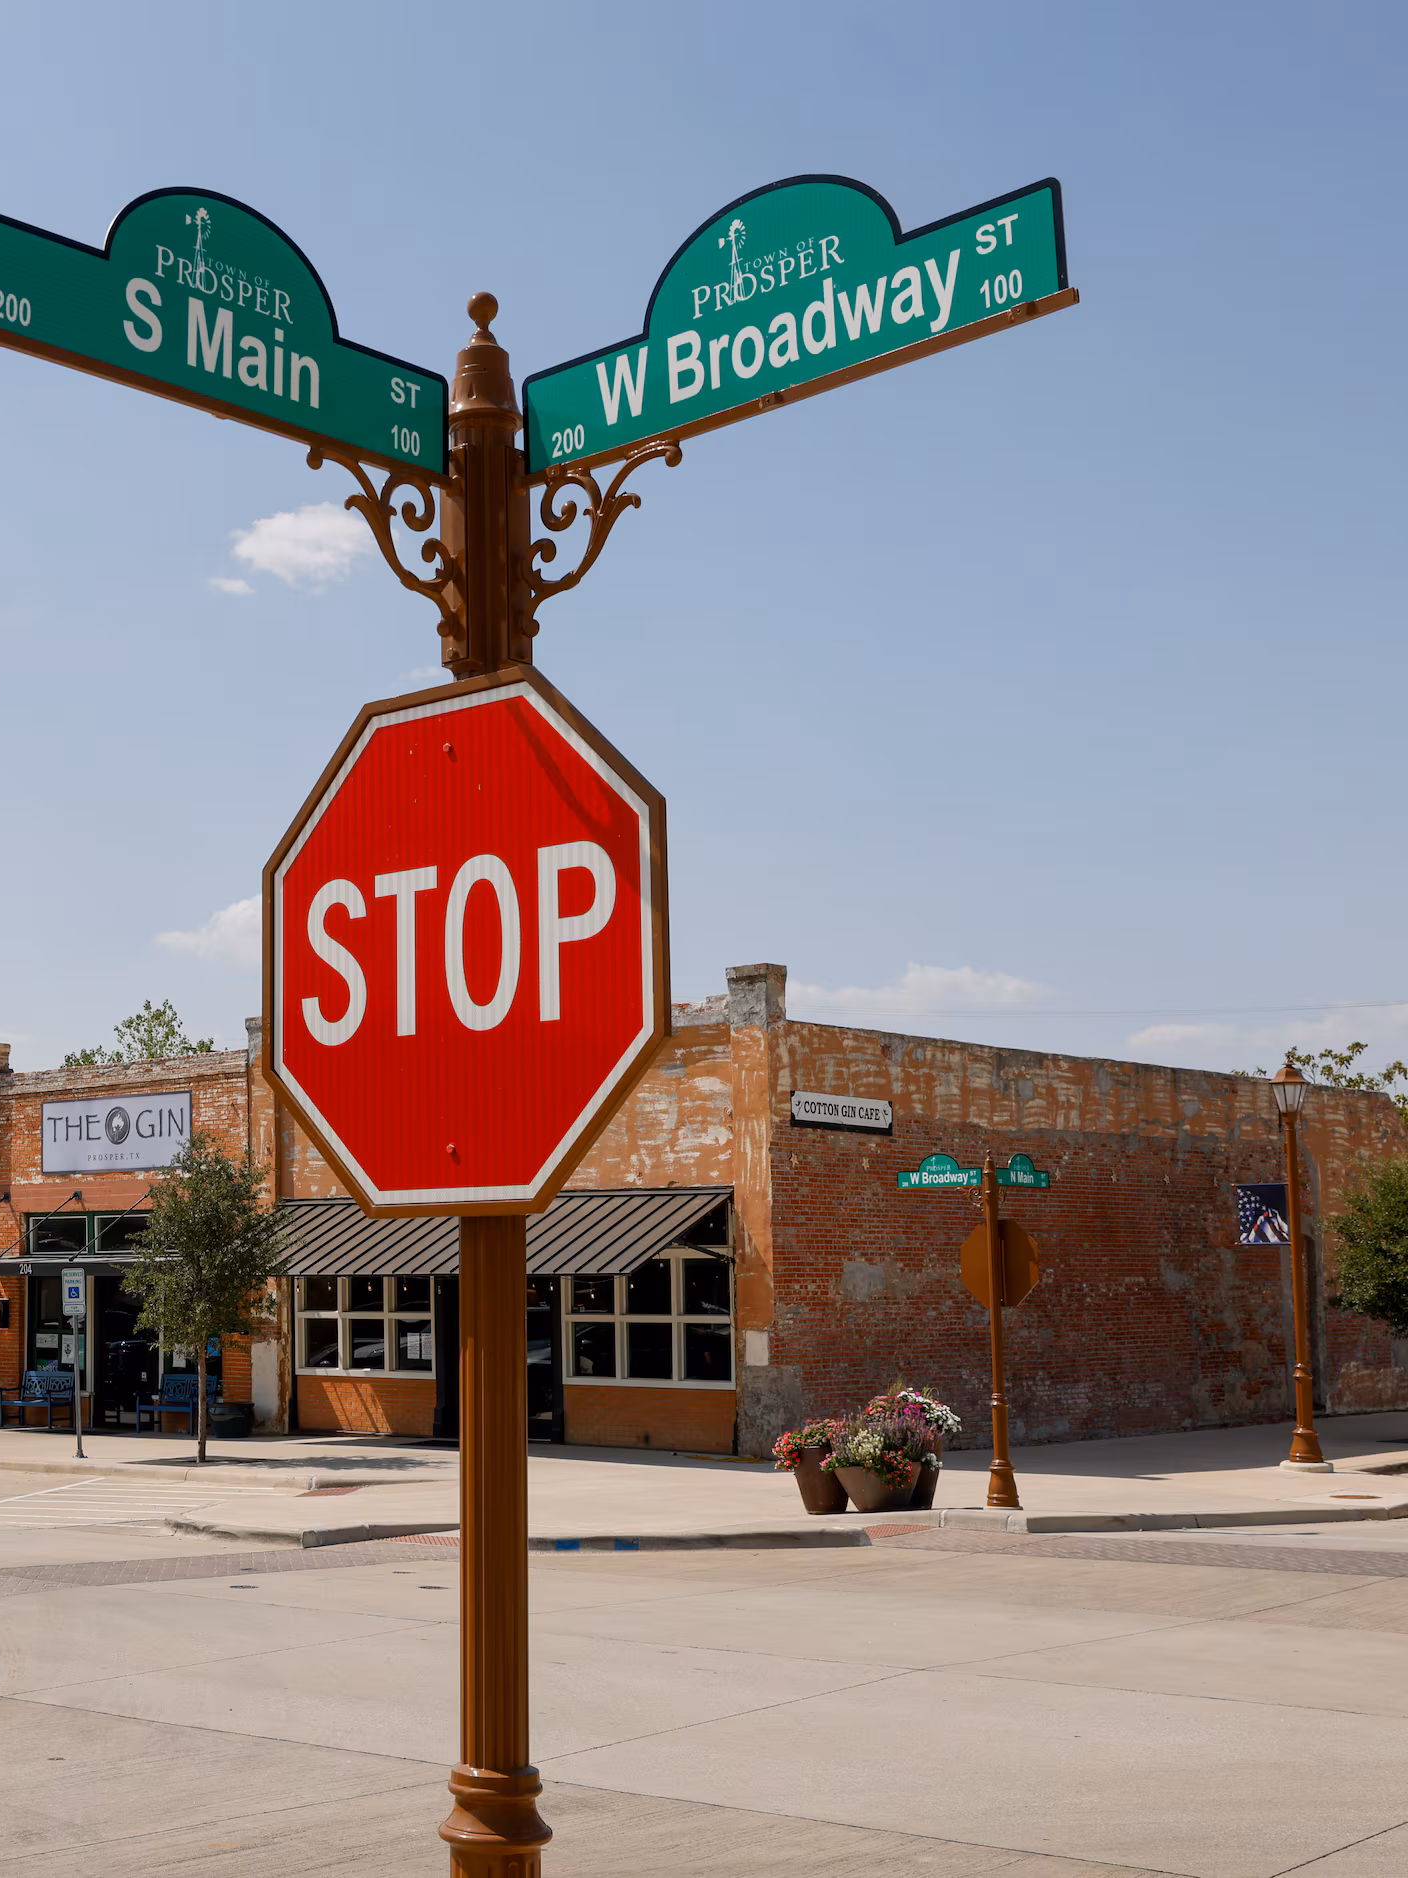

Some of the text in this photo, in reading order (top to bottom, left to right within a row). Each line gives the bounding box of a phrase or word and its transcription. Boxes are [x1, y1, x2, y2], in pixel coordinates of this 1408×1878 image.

[206, 257, 271, 288] TOWN OF
[743, 236, 815, 273] TOWN OF
[154, 244, 294, 325] PROSPER
[691, 235, 845, 320] PROSPER
[978, 268, 1024, 309] 100
[595, 213, 1020, 427] W Broadway ST
[123, 277, 421, 410] S Main ST
[390, 423, 421, 458] 100
[551, 423, 586, 460] 200
[301, 840, 617, 1047] STOP
[46, 1107, 184, 1143] THE GIN
[803, 1100, 880, 1121] COTTON GIN CAFE
[909, 1172, 920, 1185] W
[921, 1171, 969, 1186] Broadway
[1010, 1170, 1017, 1183] N
[1017, 1171, 1034, 1184] Main
[18, 1263, 33, 1275] 204
